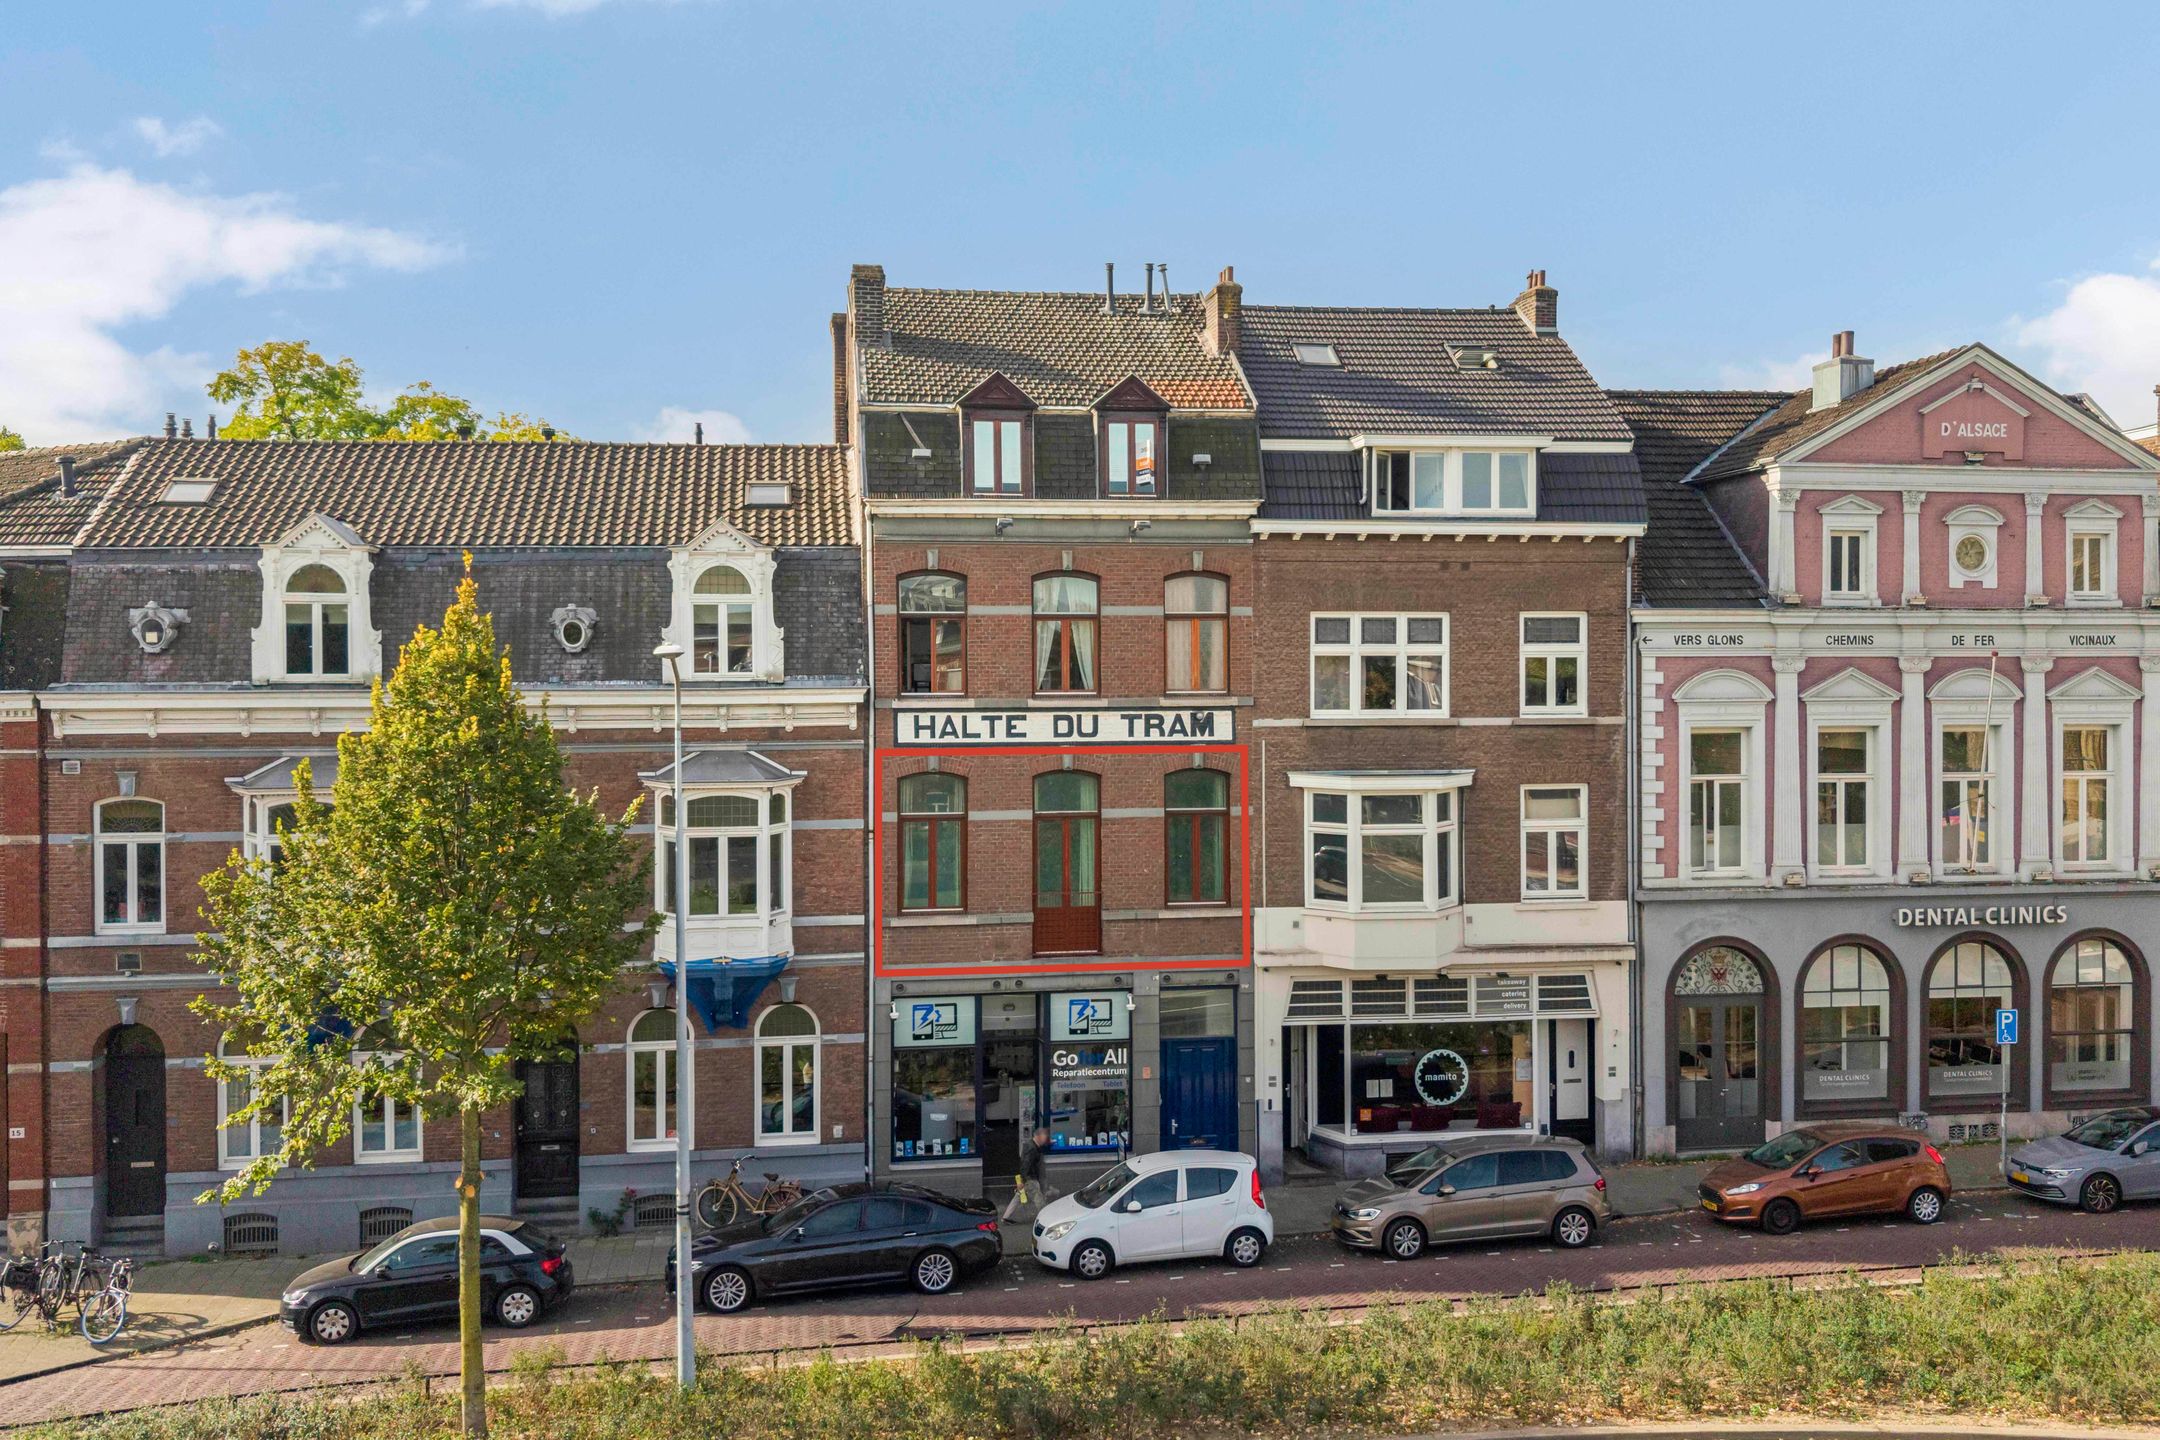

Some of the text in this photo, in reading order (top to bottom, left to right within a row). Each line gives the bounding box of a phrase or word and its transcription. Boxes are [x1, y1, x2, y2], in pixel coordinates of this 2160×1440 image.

[1941, 421, 2007, 437] D'ALSACE
[1674, 635, 1744, 645] VERS GLONS
[1826, 635, 2116, 646] CHEMINS DE FER VICINAUX
[914, 712, 1214, 739] HALTE DU TRAM
[1898, 905, 2068, 927] DENTAL CLINICS
[1497, 979, 1526, 988] takeaway
[1502, 990, 1526, 998] catering
[1503, 1002, 1527, 1010] delivery
[2001, 1012, 2013, 1030] P
[1053, 1067, 1127, 1078] Reparatiecentrum
[1425, 1071, 1458, 1081] mamito
